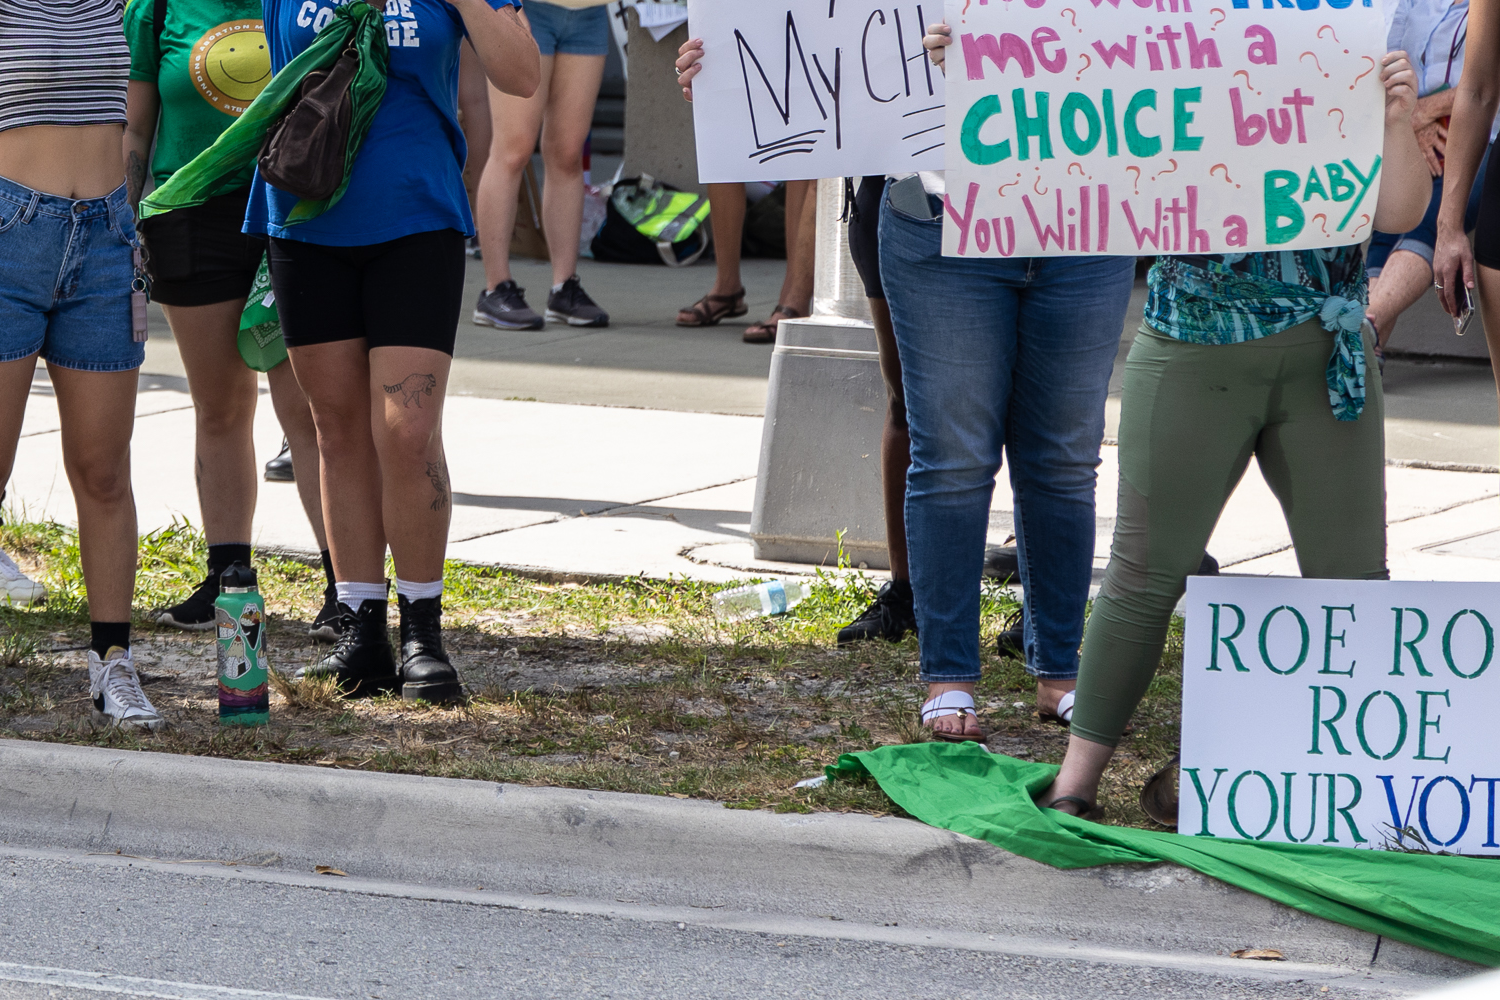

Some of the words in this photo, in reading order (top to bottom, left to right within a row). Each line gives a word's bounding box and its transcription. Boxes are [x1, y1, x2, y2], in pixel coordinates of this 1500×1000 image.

[199, 24, 250, 52] ABORTION
[296, 0, 420, 47] COGE
[961, 26, 1068, 81] me
[1091, 22, 1223, 72] with
[1244, 24, 1278, 66] a
[194, 55, 220, 102] FUNDING
[960, 86, 1204, 166] CHOICE
[1228, 87, 1315, 147] but
[943, 182, 1016, 257] You
[1222, 214, 1249, 248] a
[1264, 154, 1383, 246] BABY
[1205, 603, 1357, 678] ROE
[1388, 607, 1495, 680] RO
[1307, 685, 1451, 764] ROE
[1182, 767, 1368, 843] YOUR
[1375, 774, 1500, 847] VOT
